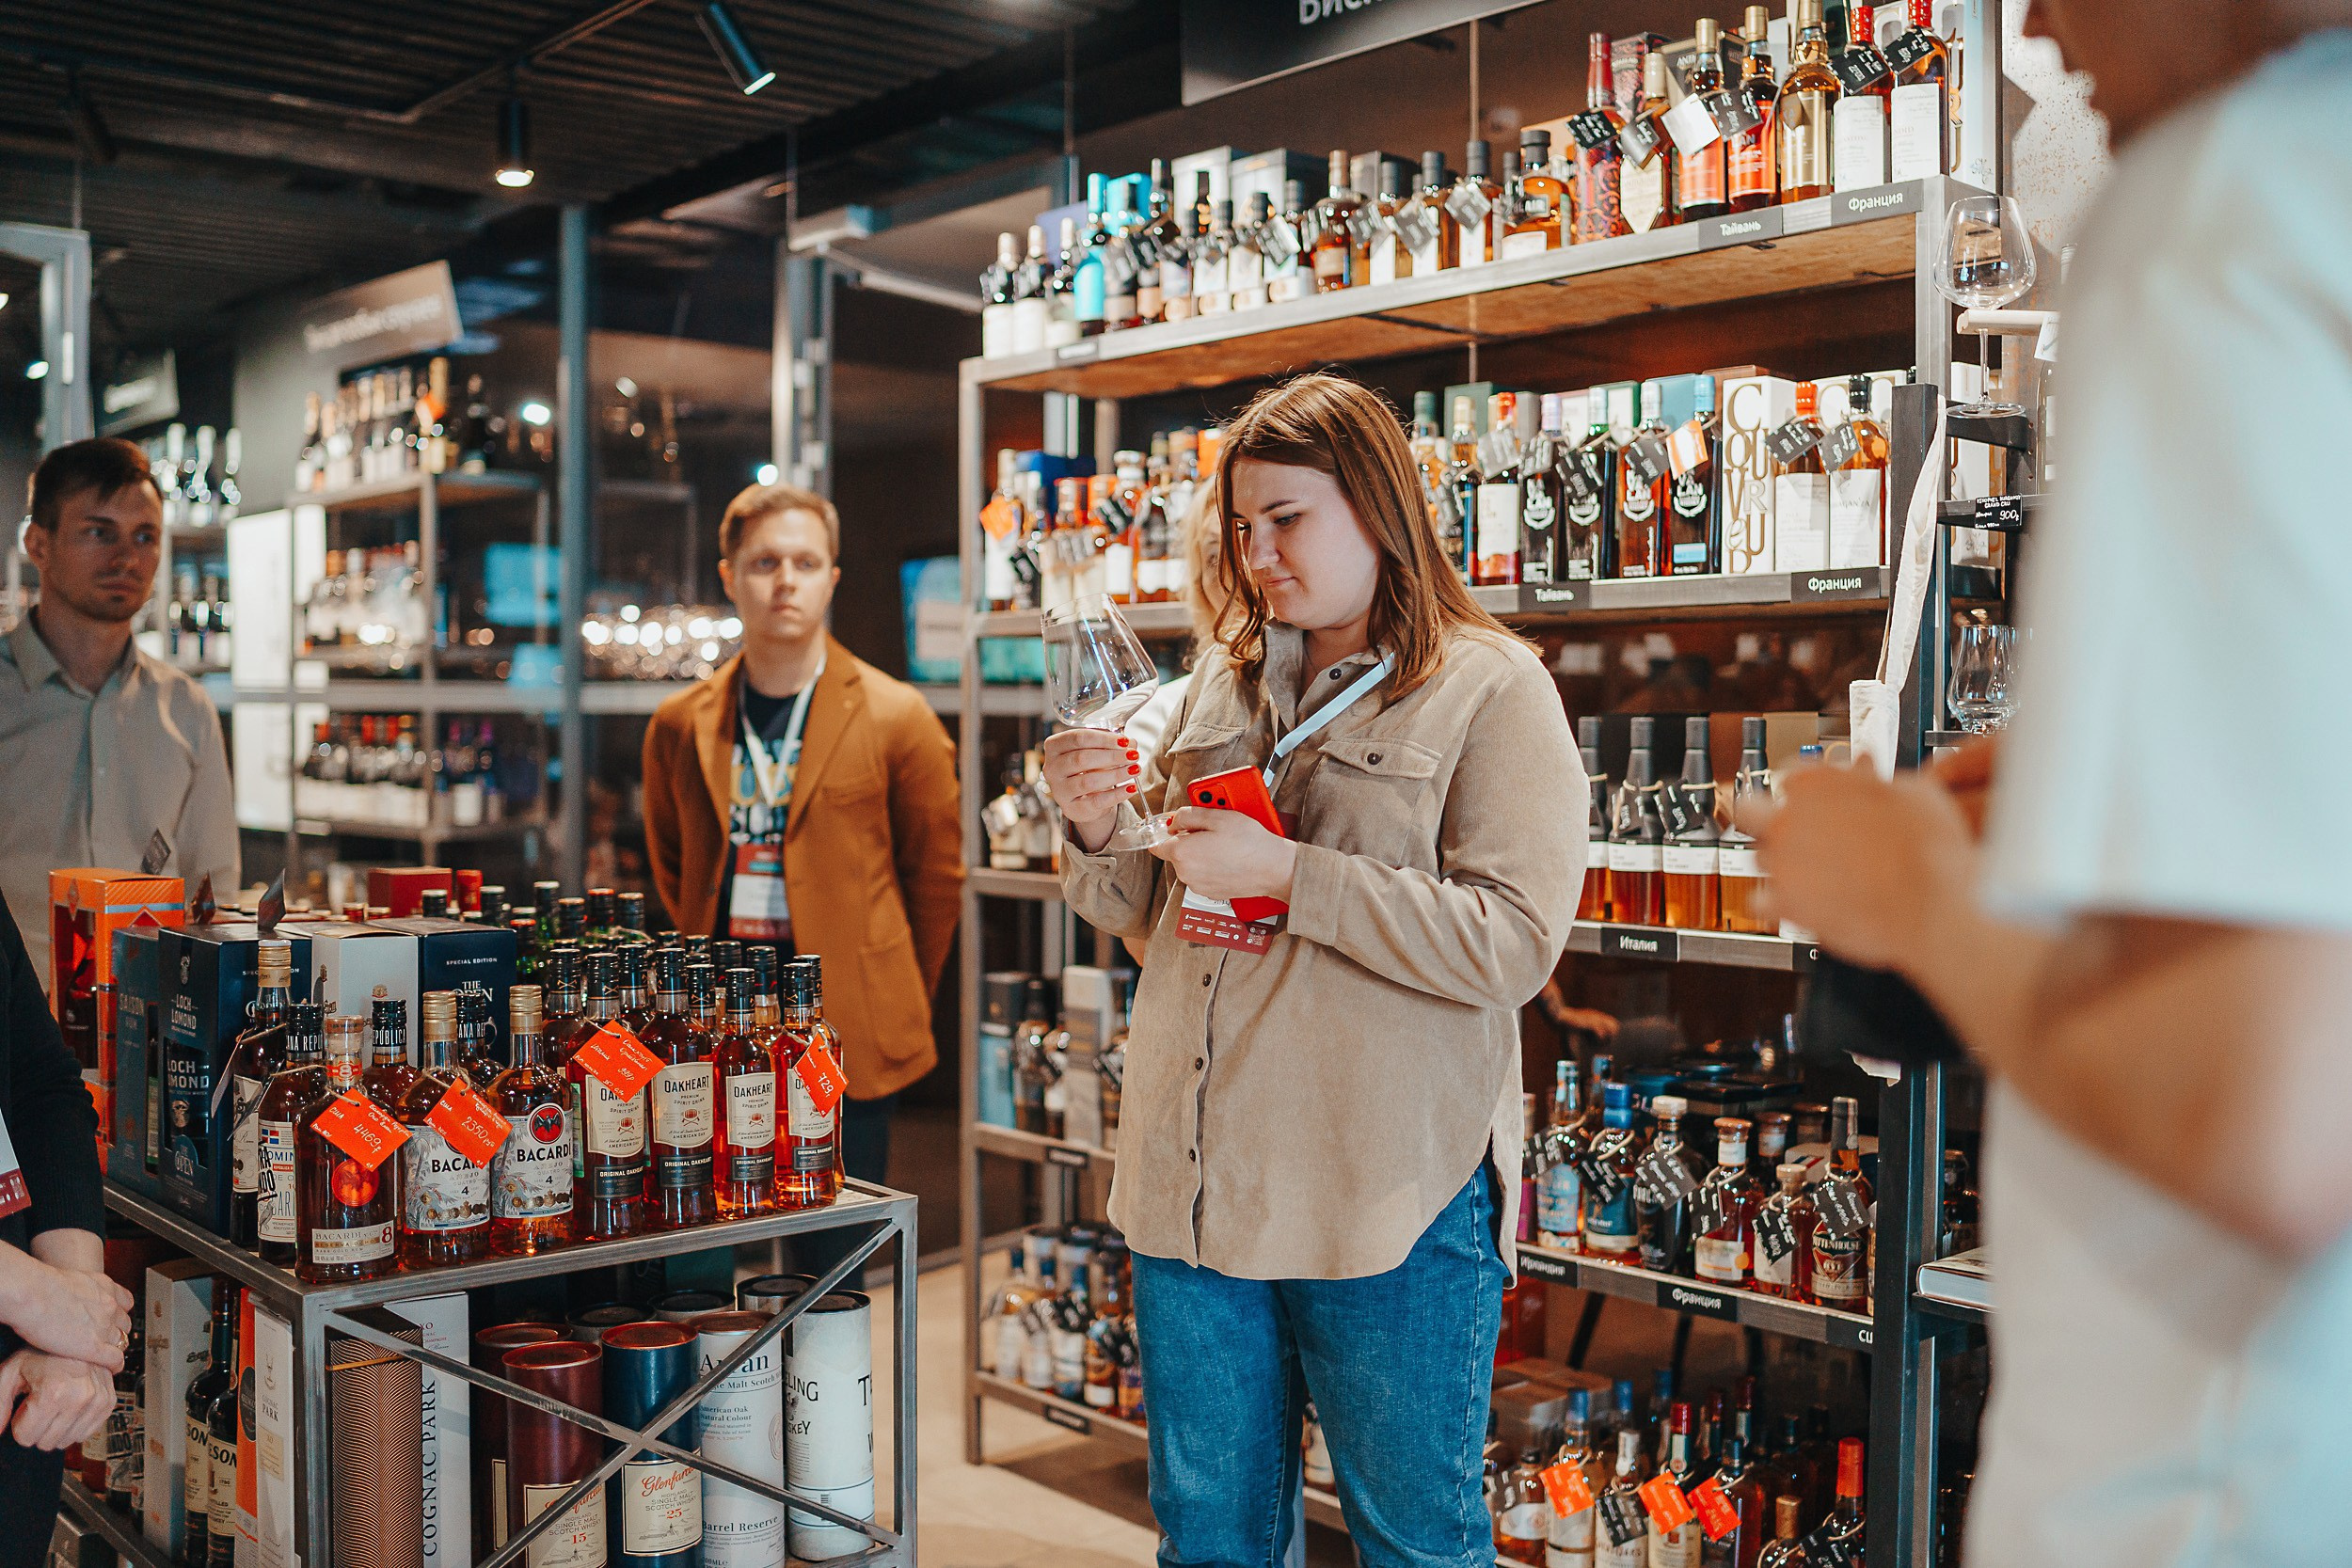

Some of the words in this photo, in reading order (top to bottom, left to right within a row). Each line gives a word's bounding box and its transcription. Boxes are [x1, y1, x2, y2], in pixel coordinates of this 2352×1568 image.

[1848, 192, 1903, 213] Франция
[1720, 221, 1762, 236] Тайвань
[1807, 577, 1862, 594] Франция
[1620, 936, 1658, 953] Италия
[462, 980, 482, 990] THE
[176, 993, 192, 1011] LOCH
[171, 1008, 197, 1030] LOMOND
[168, 1074, 209, 1089] MOND
[664, 1075, 709, 1093] OAKHEART
[734, 1082, 773, 1098] OAKHEART
[691, 1097, 706, 1105] DRINK
[432, 1157, 479, 1173] BACA
[546, 1175, 553, 1184] 4
[599, 1169, 625, 1178] ORIGINAL
[461, 1186, 469, 1196] 4
[382, 1226, 393, 1243] 8
[1672, 1288, 1722, 1309] Франция
[728, 1381, 748, 1390] Malt
[751, 1374, 775, 1387] Scotch
[262, 1402, 278, 1422] PARK
[421, 1380, 436, 1442] PARK
[651, 1496, 677, 1505] SINGLE
[678, 1491, 694, 1502] MALT
[660, 1489, 687, 1498] HIGHLAND
[422, 1451, 437, 1557] COGNAC
[645, 1502, 675, 1512] SCOTCH
[676, 1496, 697, 1508] WHISKY
[555, 1520, 582, 1529] SINGLE
[582, 1513, 598, 1526] MALT
[565, 1513, 592, 1522] HIGHLAND
[666, 1508, 683, 1519] 25
[548, 1527, 580, 1536] SCOTCH
[580, 1519, 602, 1532] WHISKY
[739, 1516, 778, 1531] Reserve
[572, 1532, 587, 1544] 15
